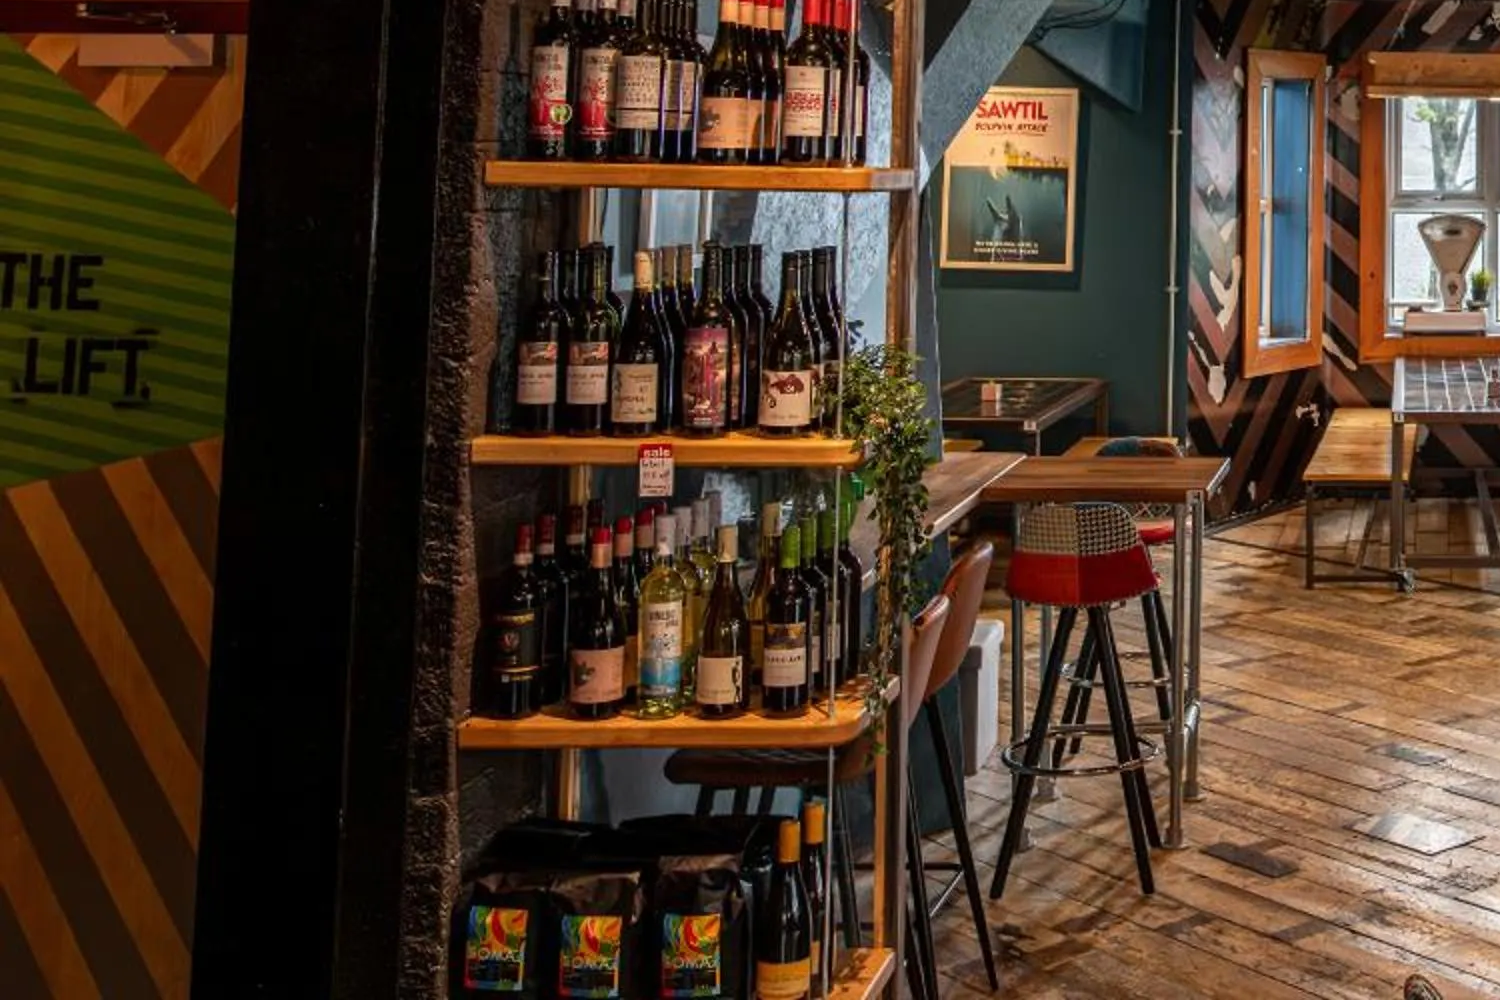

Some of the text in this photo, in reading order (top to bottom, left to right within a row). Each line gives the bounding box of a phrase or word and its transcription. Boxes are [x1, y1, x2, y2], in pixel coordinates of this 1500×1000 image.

[976, 99, 1049, 121] SAWTIL
[0, 252, 104, 311] THE
[22, 335, 157, 398] LIFT
[643, 446, 671, 457] sale
